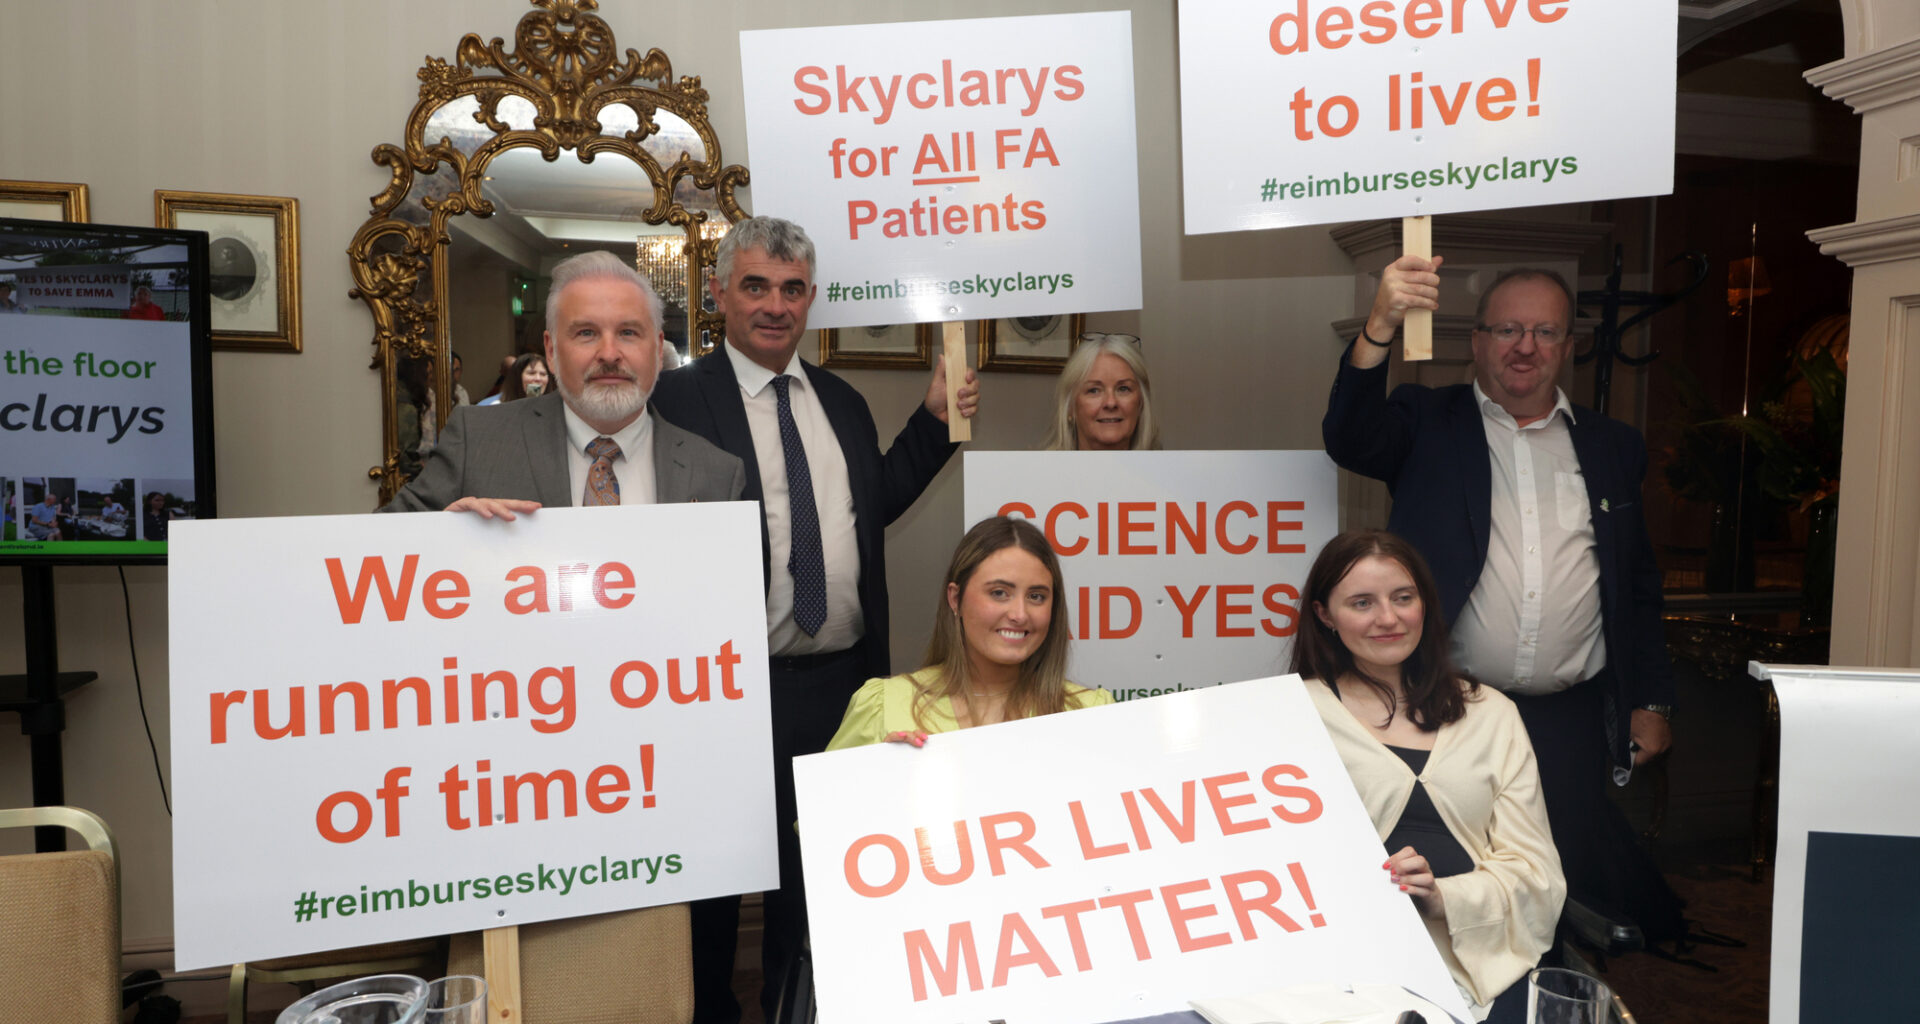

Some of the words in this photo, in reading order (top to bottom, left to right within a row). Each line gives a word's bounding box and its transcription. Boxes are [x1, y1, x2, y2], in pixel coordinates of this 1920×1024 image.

[1269, 0, 1569, 56] deserve
[793, 60, 1085, 125] Skyclarys
[1289, 87, 1360, 142] to
[1388, 58, 1541, 132] live!
[828, 138, 899, 179] for
[912, 131, 980, 177] All
[995, 128, 1060, 170] FA
[1260, 155, 1579, 202] #reimburseskyclarys
[847, 194, 1047, 240] Patients
[18, 274, 37, 284] YES
[40, 274, 53, 284] TO
[56, 273, 129, 285] SKYCLARYS
[28, 287, 42, 297] TO
[44, 288, 73, 298] SAVE
[76, 288, 115, 298] EMMA
[827, 271, 1074, 303] #reimbseskyclarys
[4, 350, 63, 376] the
[73, 352, 157, 379] floor
[0, 393, 165, 444] clarys
[324, 553, 471, 625] We
[503, 560, 637, 617] are
[1164, 583, 1301, 638] YES
[209, 656, 577, 745] running
[610, 639, 745, 709] out
[315, 766, 412, 844] of
[438, 743, 657, 832] time!
[843, 811, 1051, 898] OUR
[1068, 763, 1324, 861] LIVES
[294, 852, 684, 923] #reimburseskyclarys
[903, 861, 1327, 1002] MATTER!
